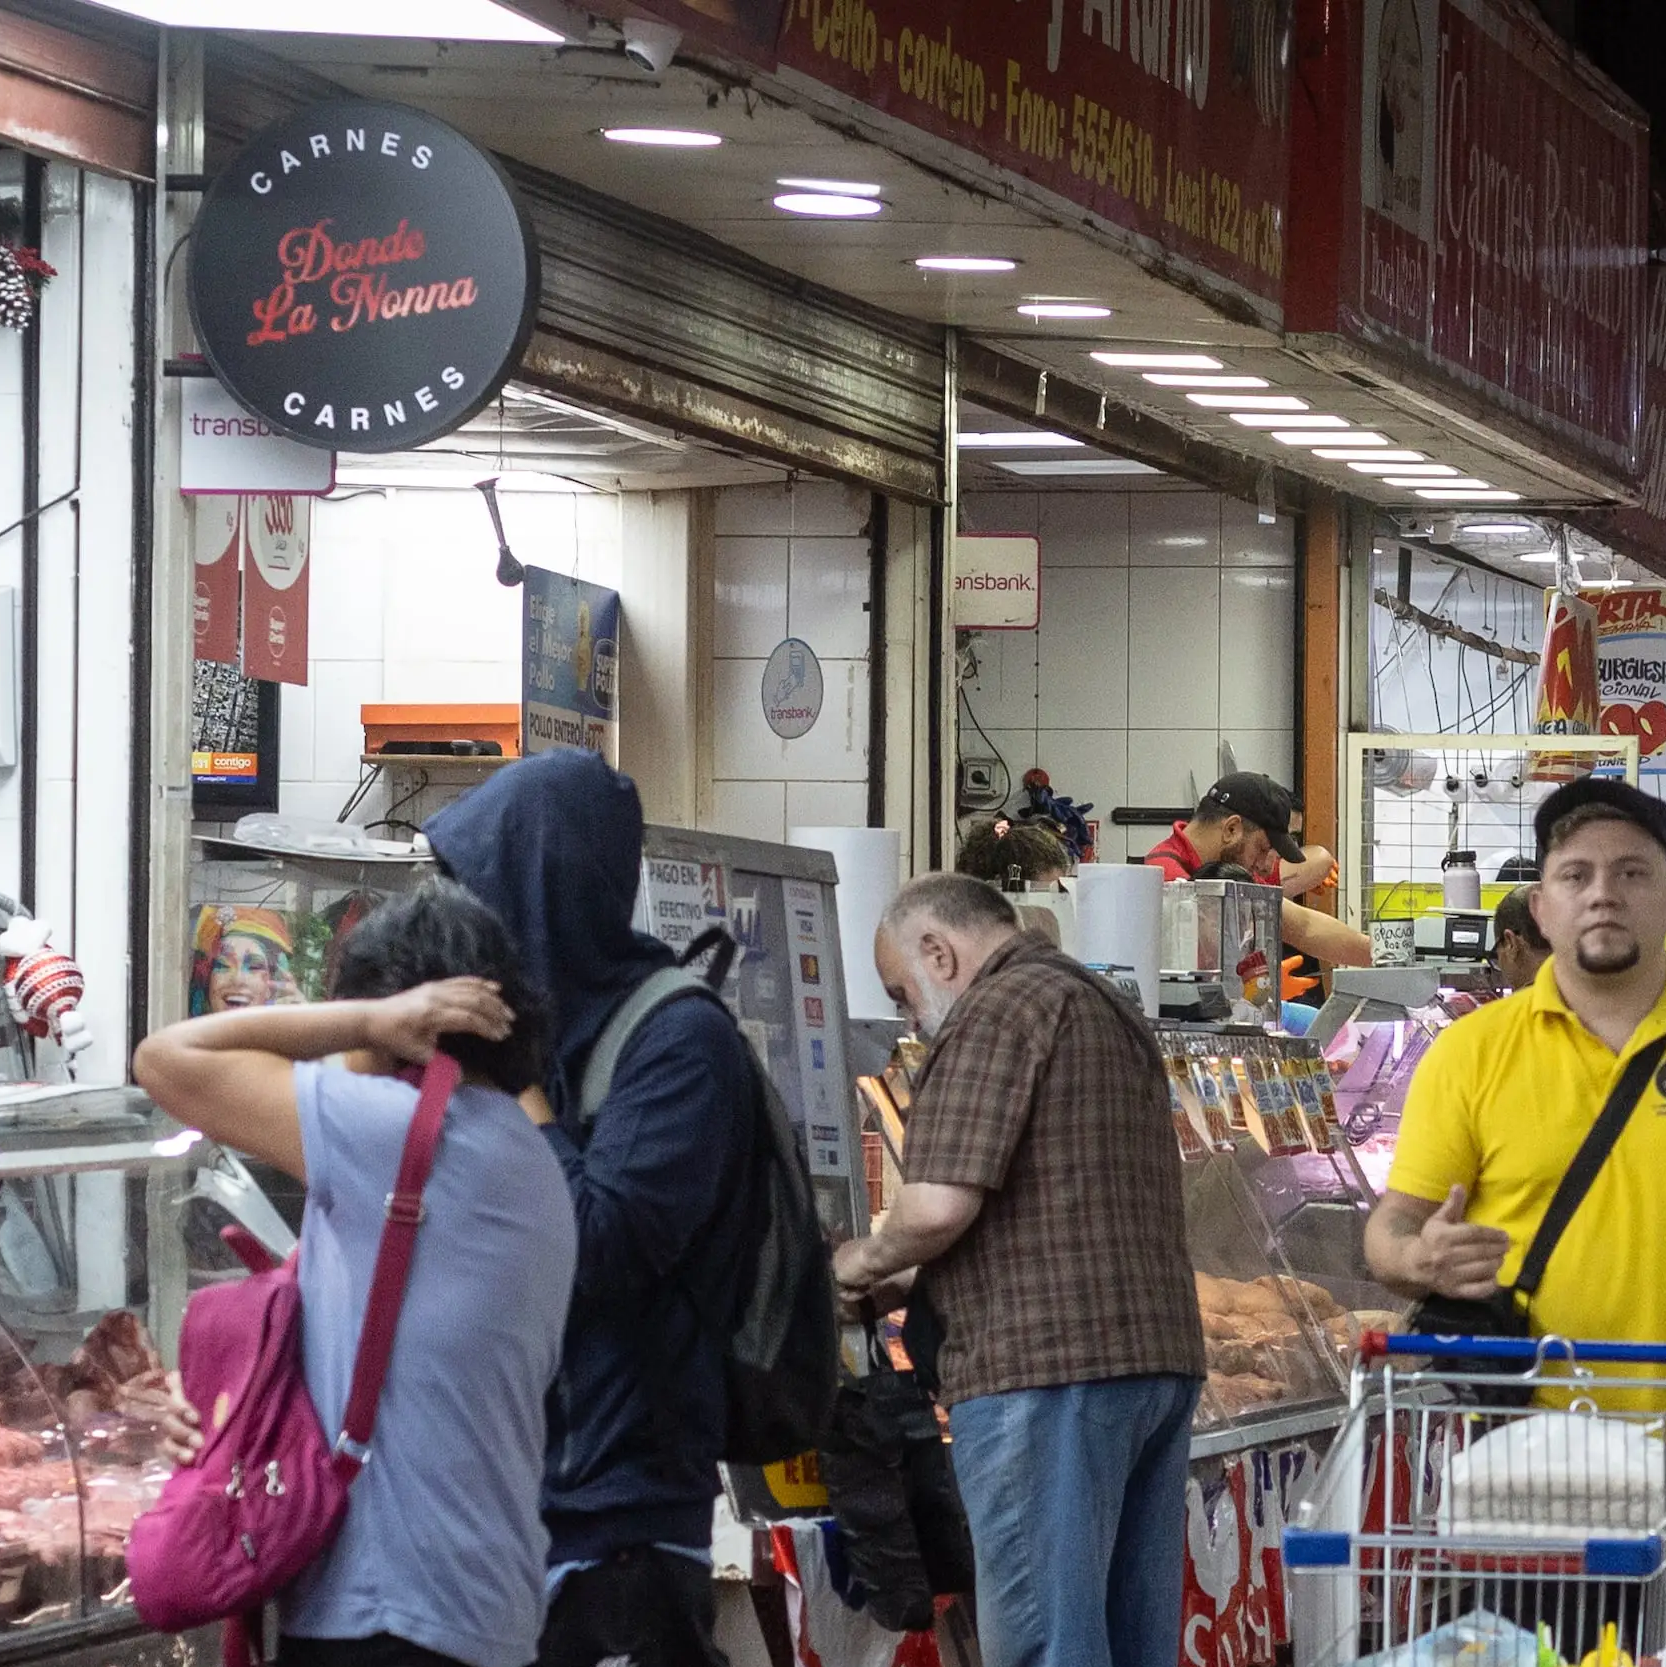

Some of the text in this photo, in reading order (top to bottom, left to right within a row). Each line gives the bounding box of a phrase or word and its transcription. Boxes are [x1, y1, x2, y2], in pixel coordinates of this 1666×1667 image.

[897, 26, 986, 129] cordero
[1004, 59, 1066, 162] Fono:
[250, 128, 433, 195] CARNES
[278, 218, 426, 283] Donde
[246, 272, 478, 346] La Nonna
[284, 366, 465, 431] CARNES
[541, 632, 572, 663] Mejor
[528, 662, 555, 692] Pollo
[529, 711, 553, 740] POLLO
[554, 717, 581, 748] ENTERO
[213, 756, 252, 769] contigo
[648, 862, 699, 887] PAGO EN:
[658, 900, 702, 921] EFECTIVO
